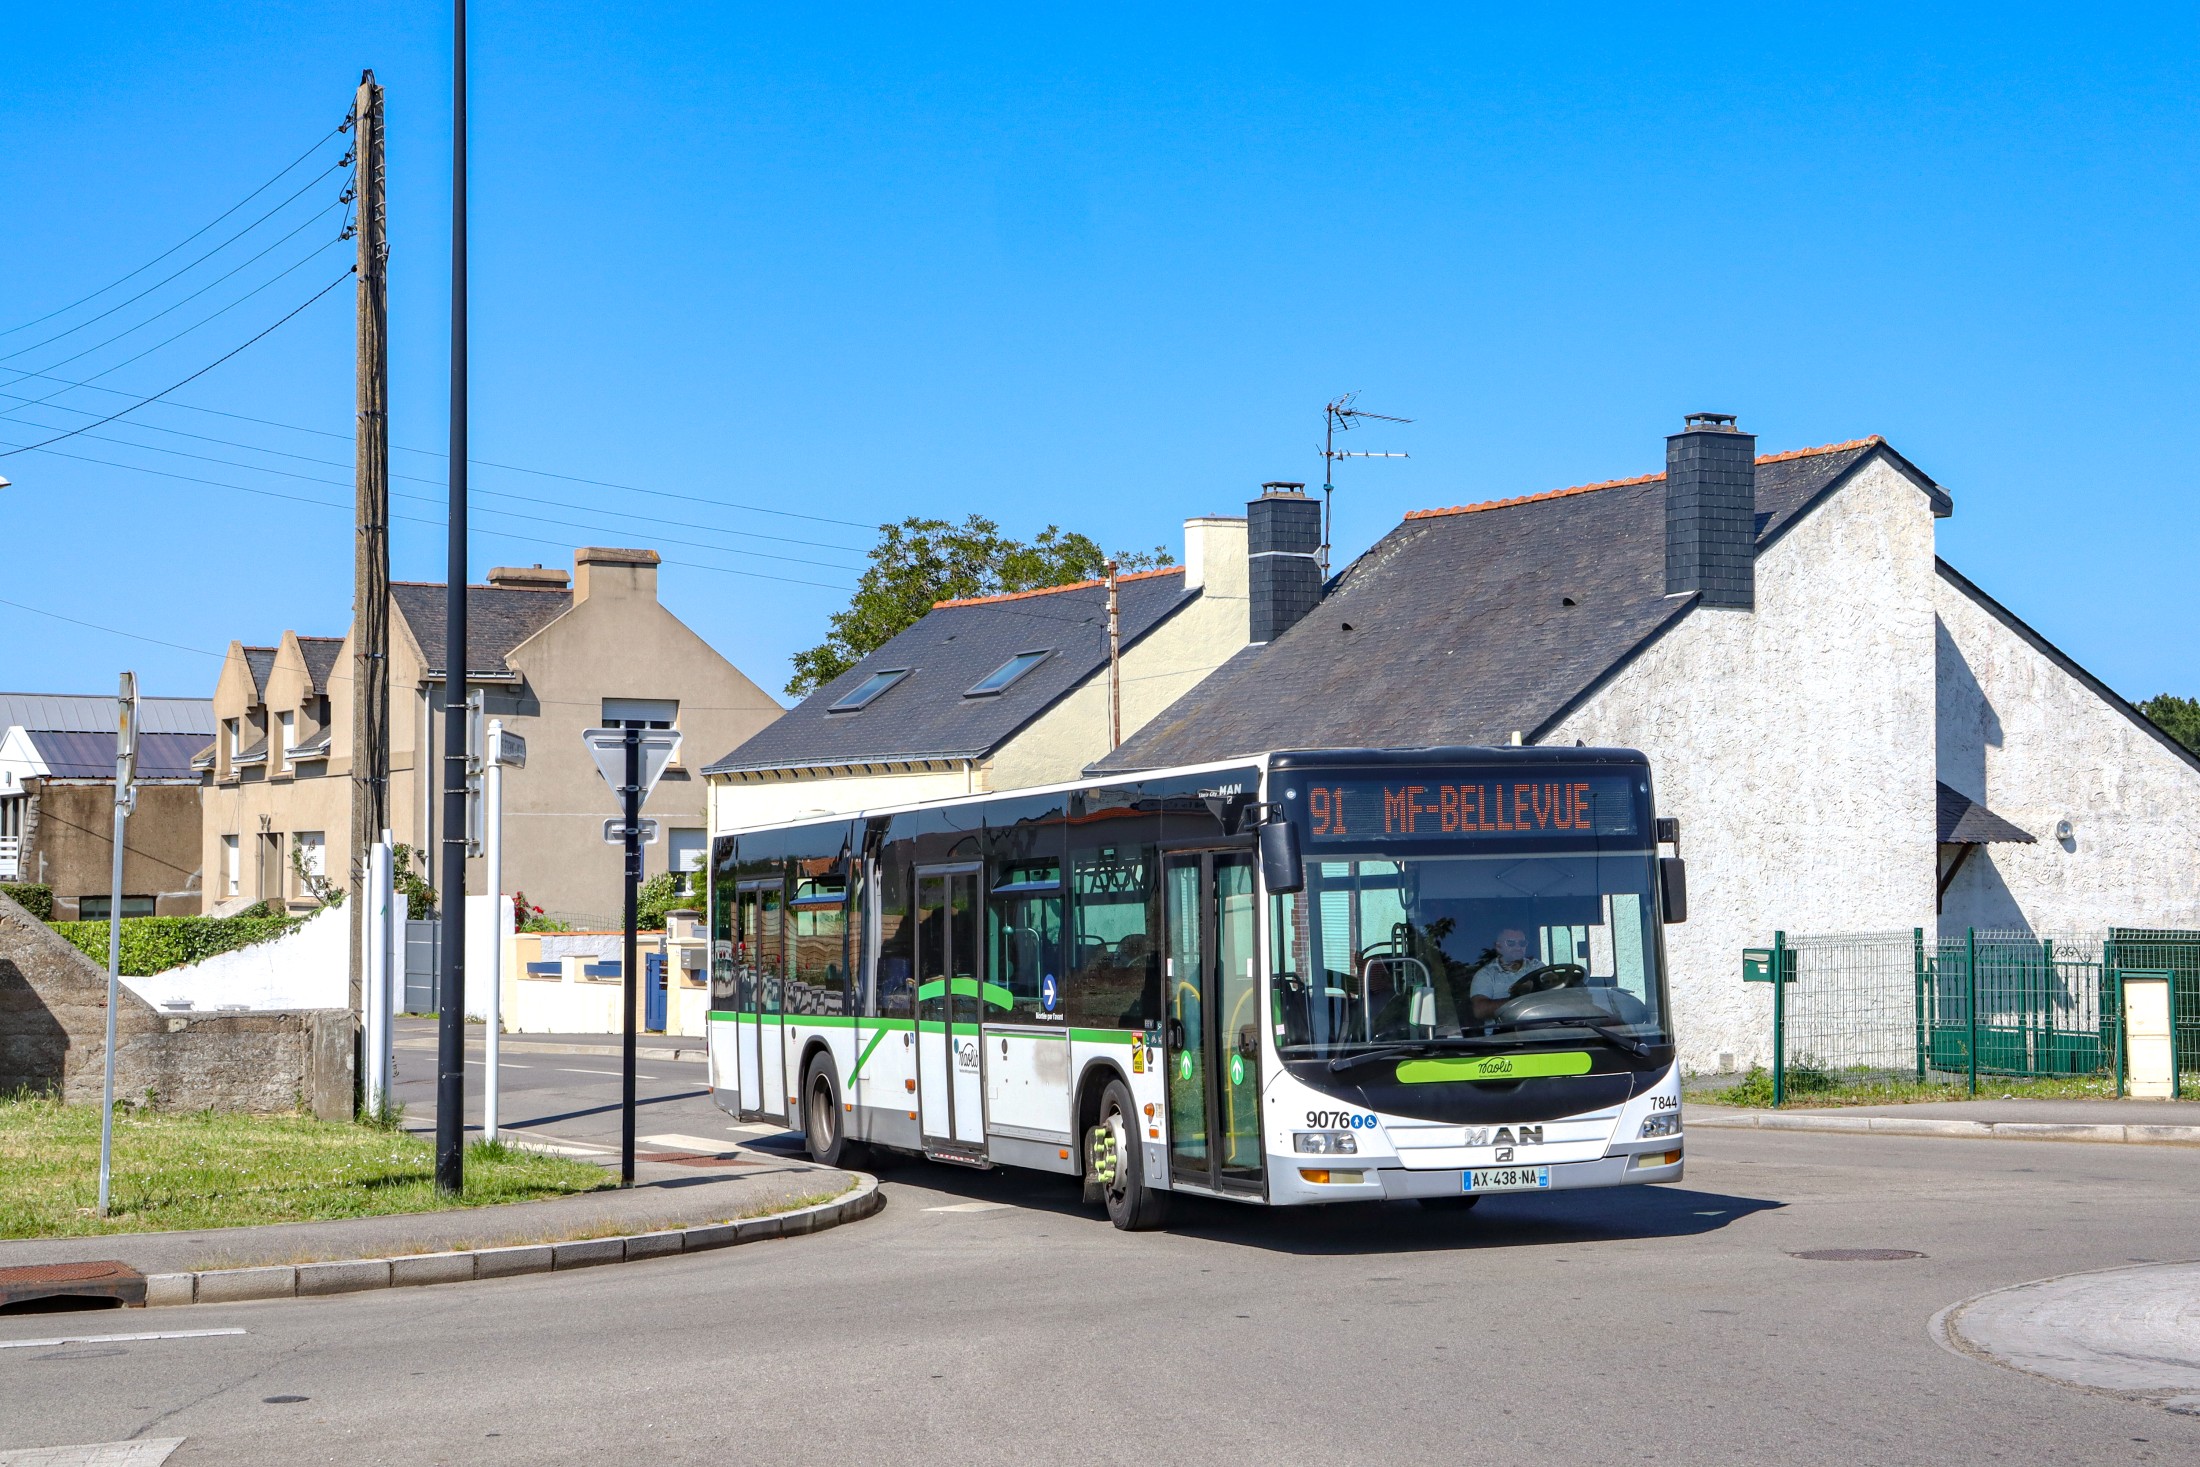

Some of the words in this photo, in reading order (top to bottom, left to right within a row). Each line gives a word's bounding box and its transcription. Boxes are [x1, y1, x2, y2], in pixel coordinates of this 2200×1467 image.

[1220, 784, 1242, 796] MAN
[1310, 787, 1347, 835] 91
[1384, 783, 1591, 833] MF-BELLEVUE
[1650, 1095, 1678, 1110] 7844
[1306, 1110, 1350, 1129] 9076
[1465, 1126, 1544, 1146] MAN
